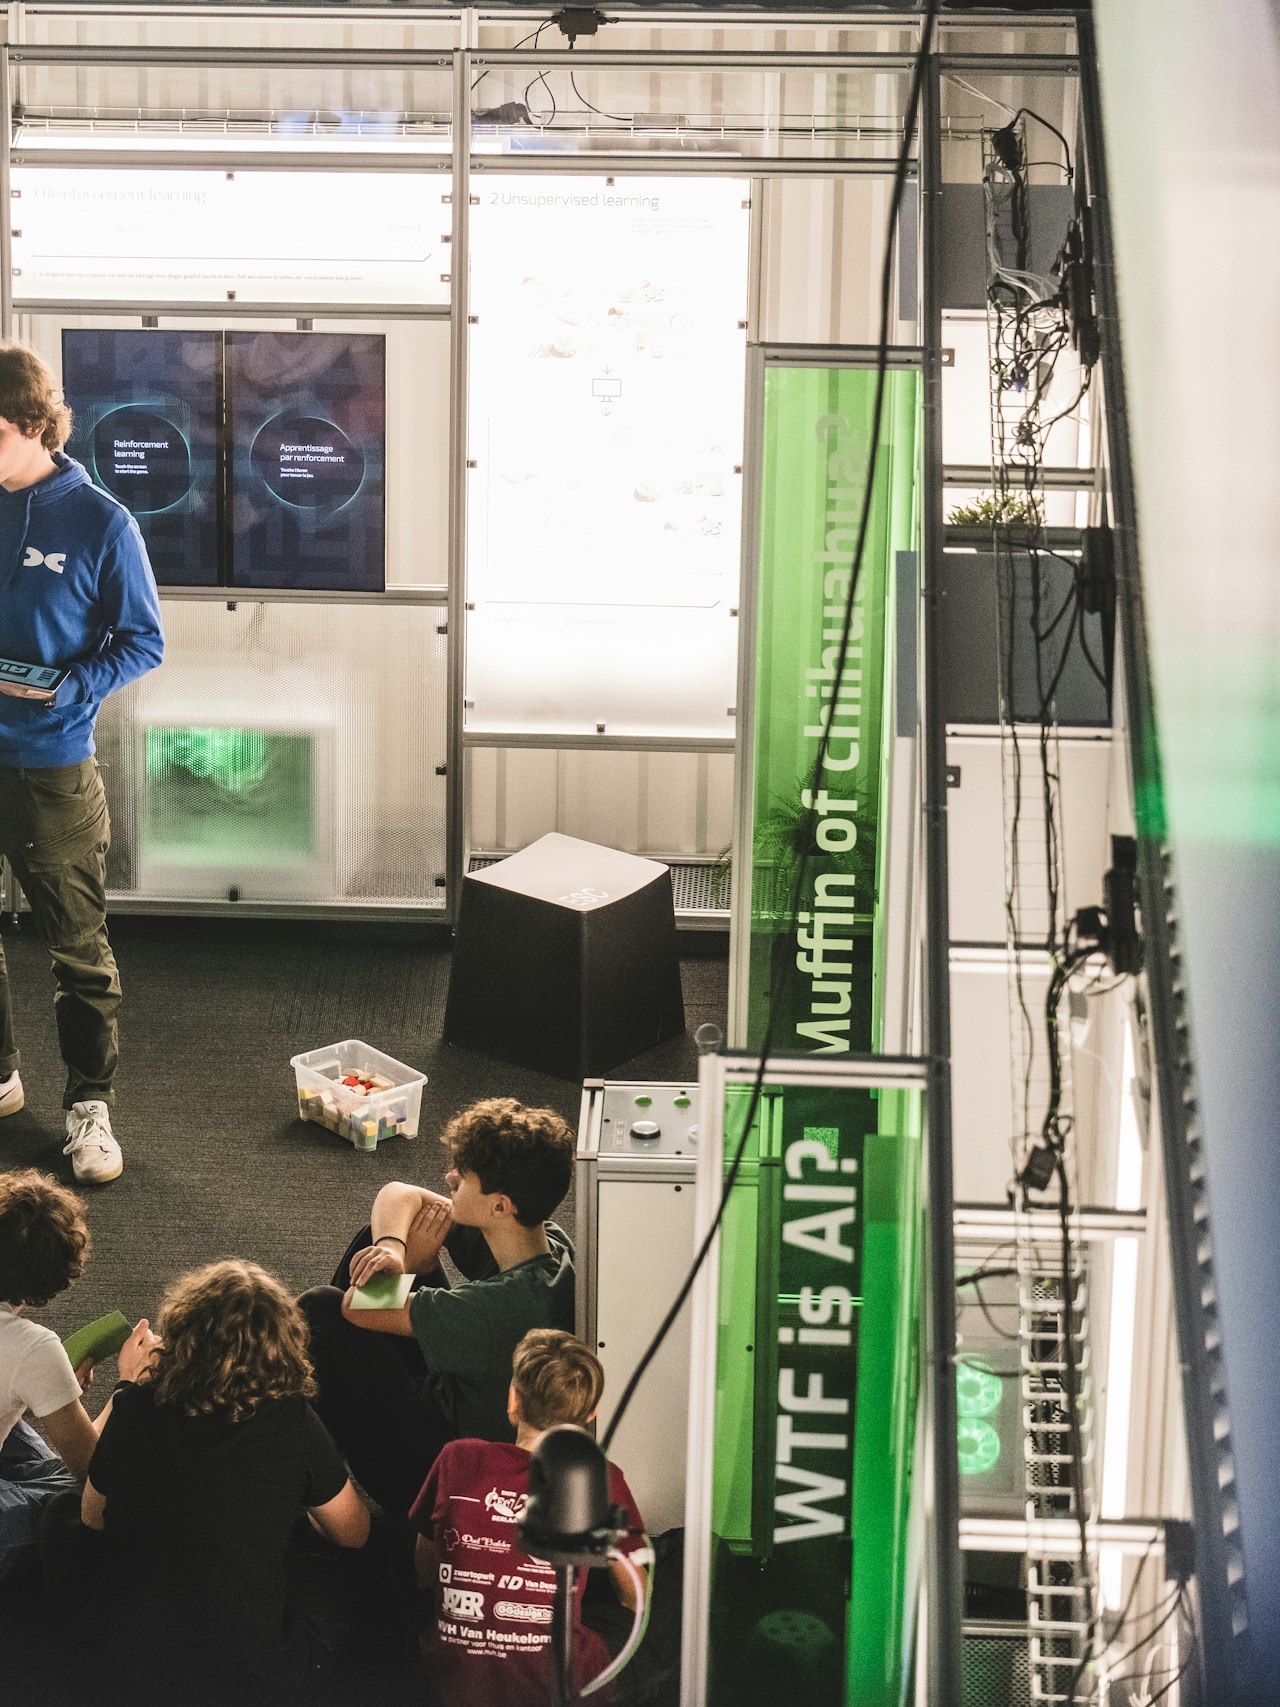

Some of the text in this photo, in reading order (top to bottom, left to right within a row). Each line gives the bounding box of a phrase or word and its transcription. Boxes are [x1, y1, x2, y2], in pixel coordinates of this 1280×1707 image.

[489, 192, 660, 211] 2 Unsupervised learning
[114, 440, 169, 448] Reinforcement
[280, 443, 334, 453] Apprentissage
[114, 450, 145, 459] learning
[280, 454, 345, 462] par renforcement
[557, 888, 609, 906] ESC
[796, 789, 858, 1054] of Muffin
[774, 1138, 859, 1543] WTF is AI?
[454, 1569, 495, 1582] zwartopwit
[525, 1580, 539, 1588] Van
[460, 1625, 483, 1640] Van
[486, 1629, 552, 1644] Heukelom
[471, 1640, 486, 1648] voor
[487, 1641, 504, 1649] thuis
[516, 1644, 543, 1652] kantoor
